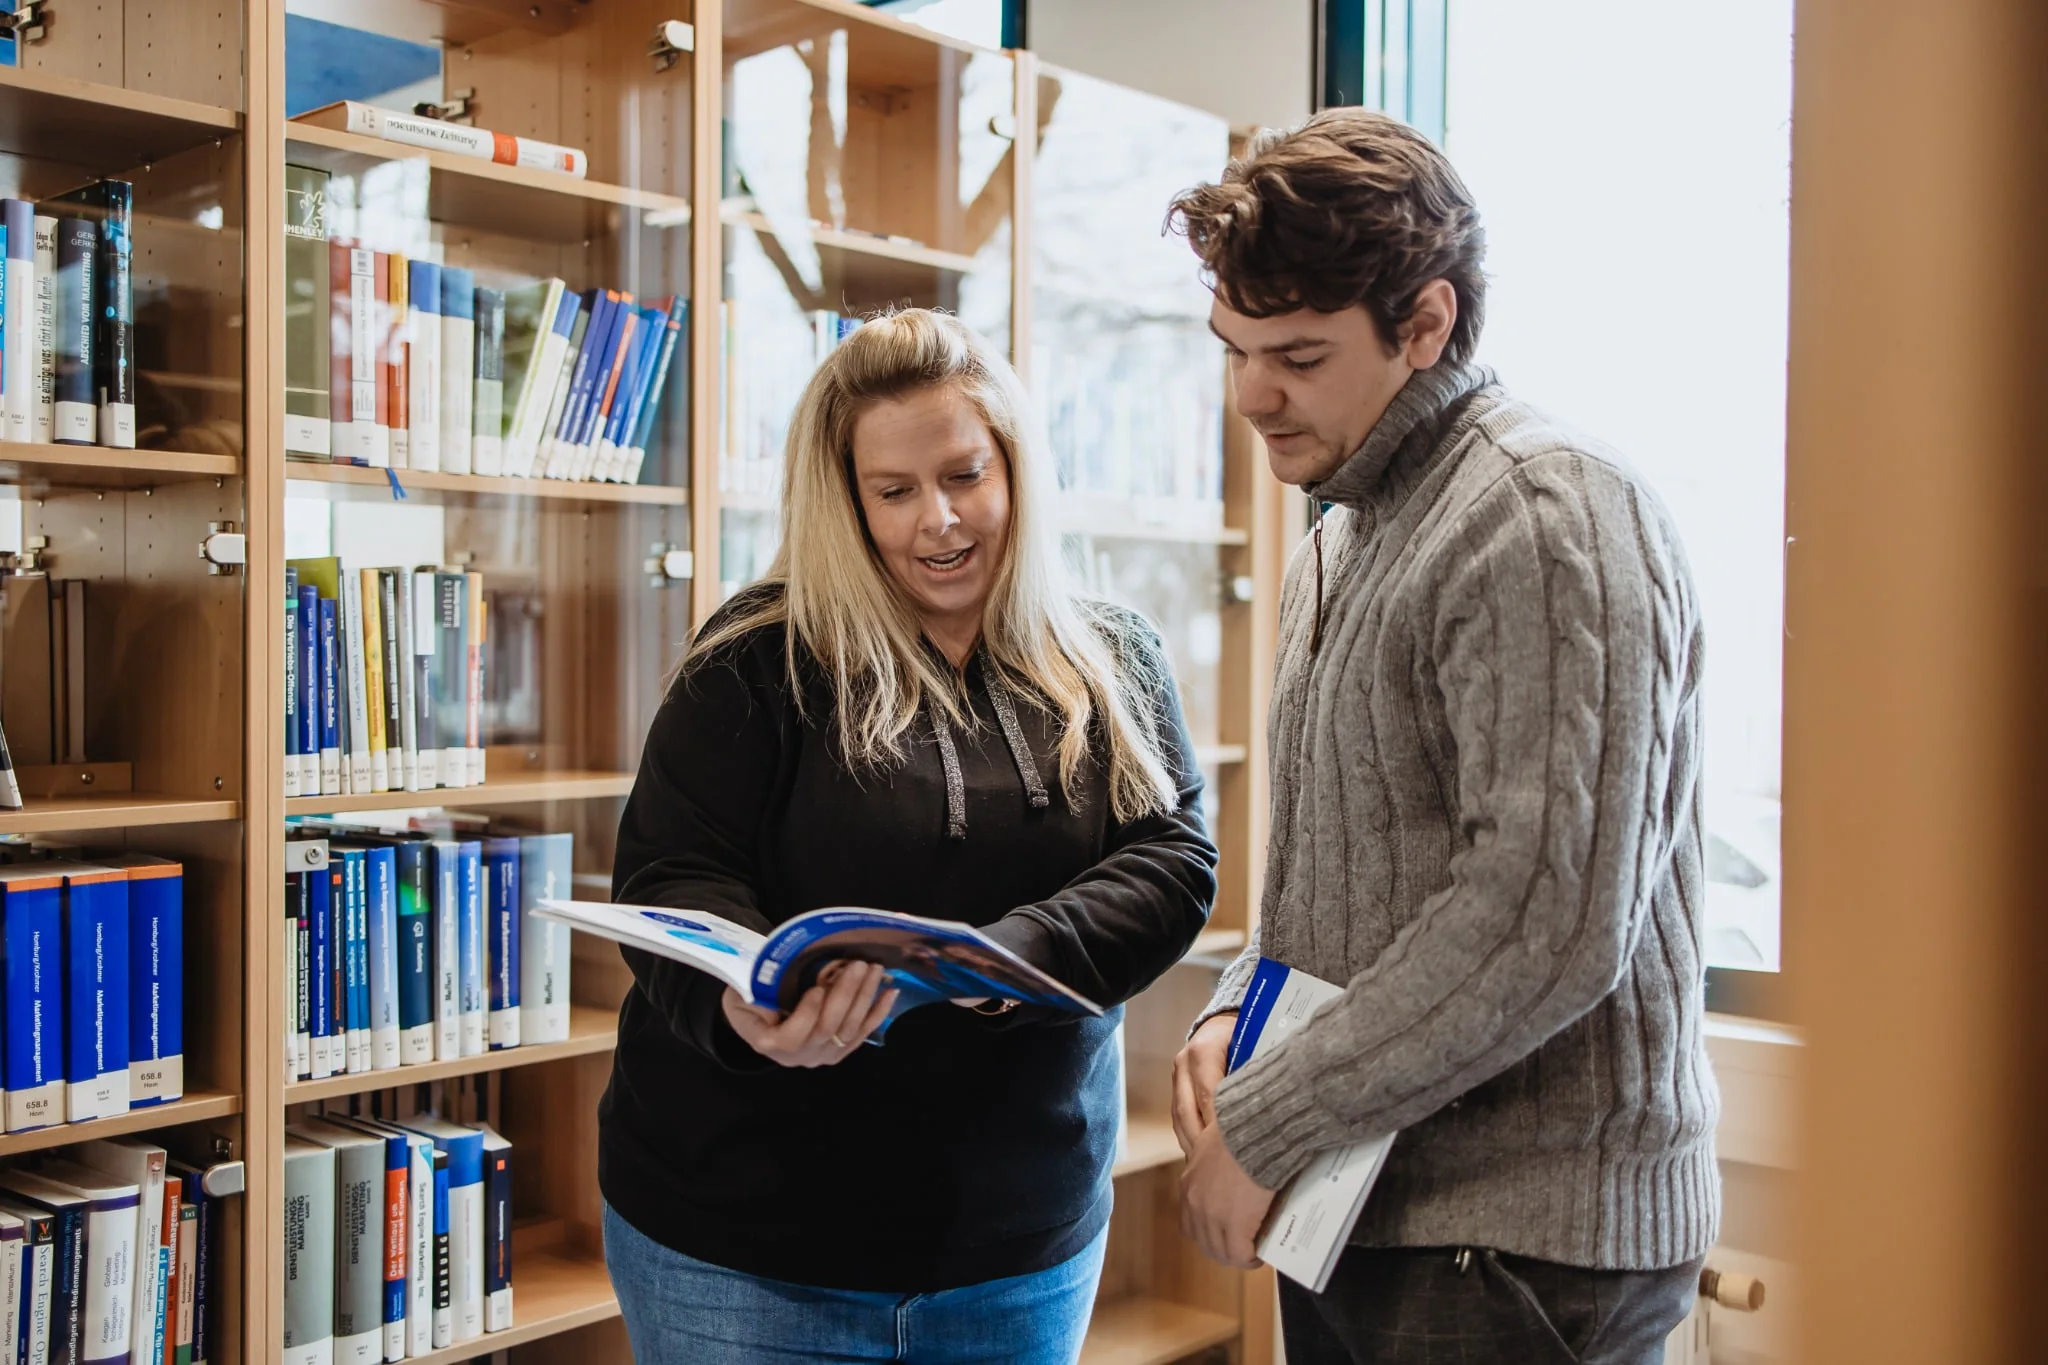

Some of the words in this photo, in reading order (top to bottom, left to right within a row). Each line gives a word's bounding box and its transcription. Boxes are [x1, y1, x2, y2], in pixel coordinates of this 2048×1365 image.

[37, 276, 52, 301] Kunde
[83, 252, 92, 302] MARKETING
[38, 303, 51, 314] der
[39, 317, 50, 327] ist
[82, 304, 91, 323] VOM
[38, 329, 51, 347] stört
[42, 350, 53, 364] was
[80, 326, 90, 364] ABSCHIED
[287, 615, 295, 629] Die
[286, 631, 295, 716] Vertriebs-Offensive
[33, 931, 41, 992] Homburg/Krohmer
[95, 922, 103, 983] Homburg/Krohmer
[151, 917, 159, 976] Homburg/Krohmer
[33, 999, 42, 1082] Marketingmanagement
[96, 989, 104, 1070] Marketingmanagement
[151, 982, 159, 1059] Marketingmanagemen
[140, 1072, 162, 1081] 658.8
[26, 1099, 48, 1110] 658.8
[168, 1195, 179, 1276] Eventmanagement
[297, 1195, 305, 1250] MARKETING
[351, 1182, 359, 1264] DIENSTLEISTUNGS-
[418, 1212, 426, 1239] Engine
[7, 1263, 15, 1305] Intensivkurs
[38, 1247, 50, 1288] Search
[71, 1228, 83, 1308] Medienmanagements
[103, 1257, 112, 1289] Globales
[390, 1261, 398, 1278] Der
[439, 1235, 449, 1308] FÜHRUNG
[147, 1273, 155, 1312] Management
[5, 1311, 15, 1347] Marketing
[34, 1292, 49, 1336] Engine
[101, 1317, 110, 1343] Keegan
